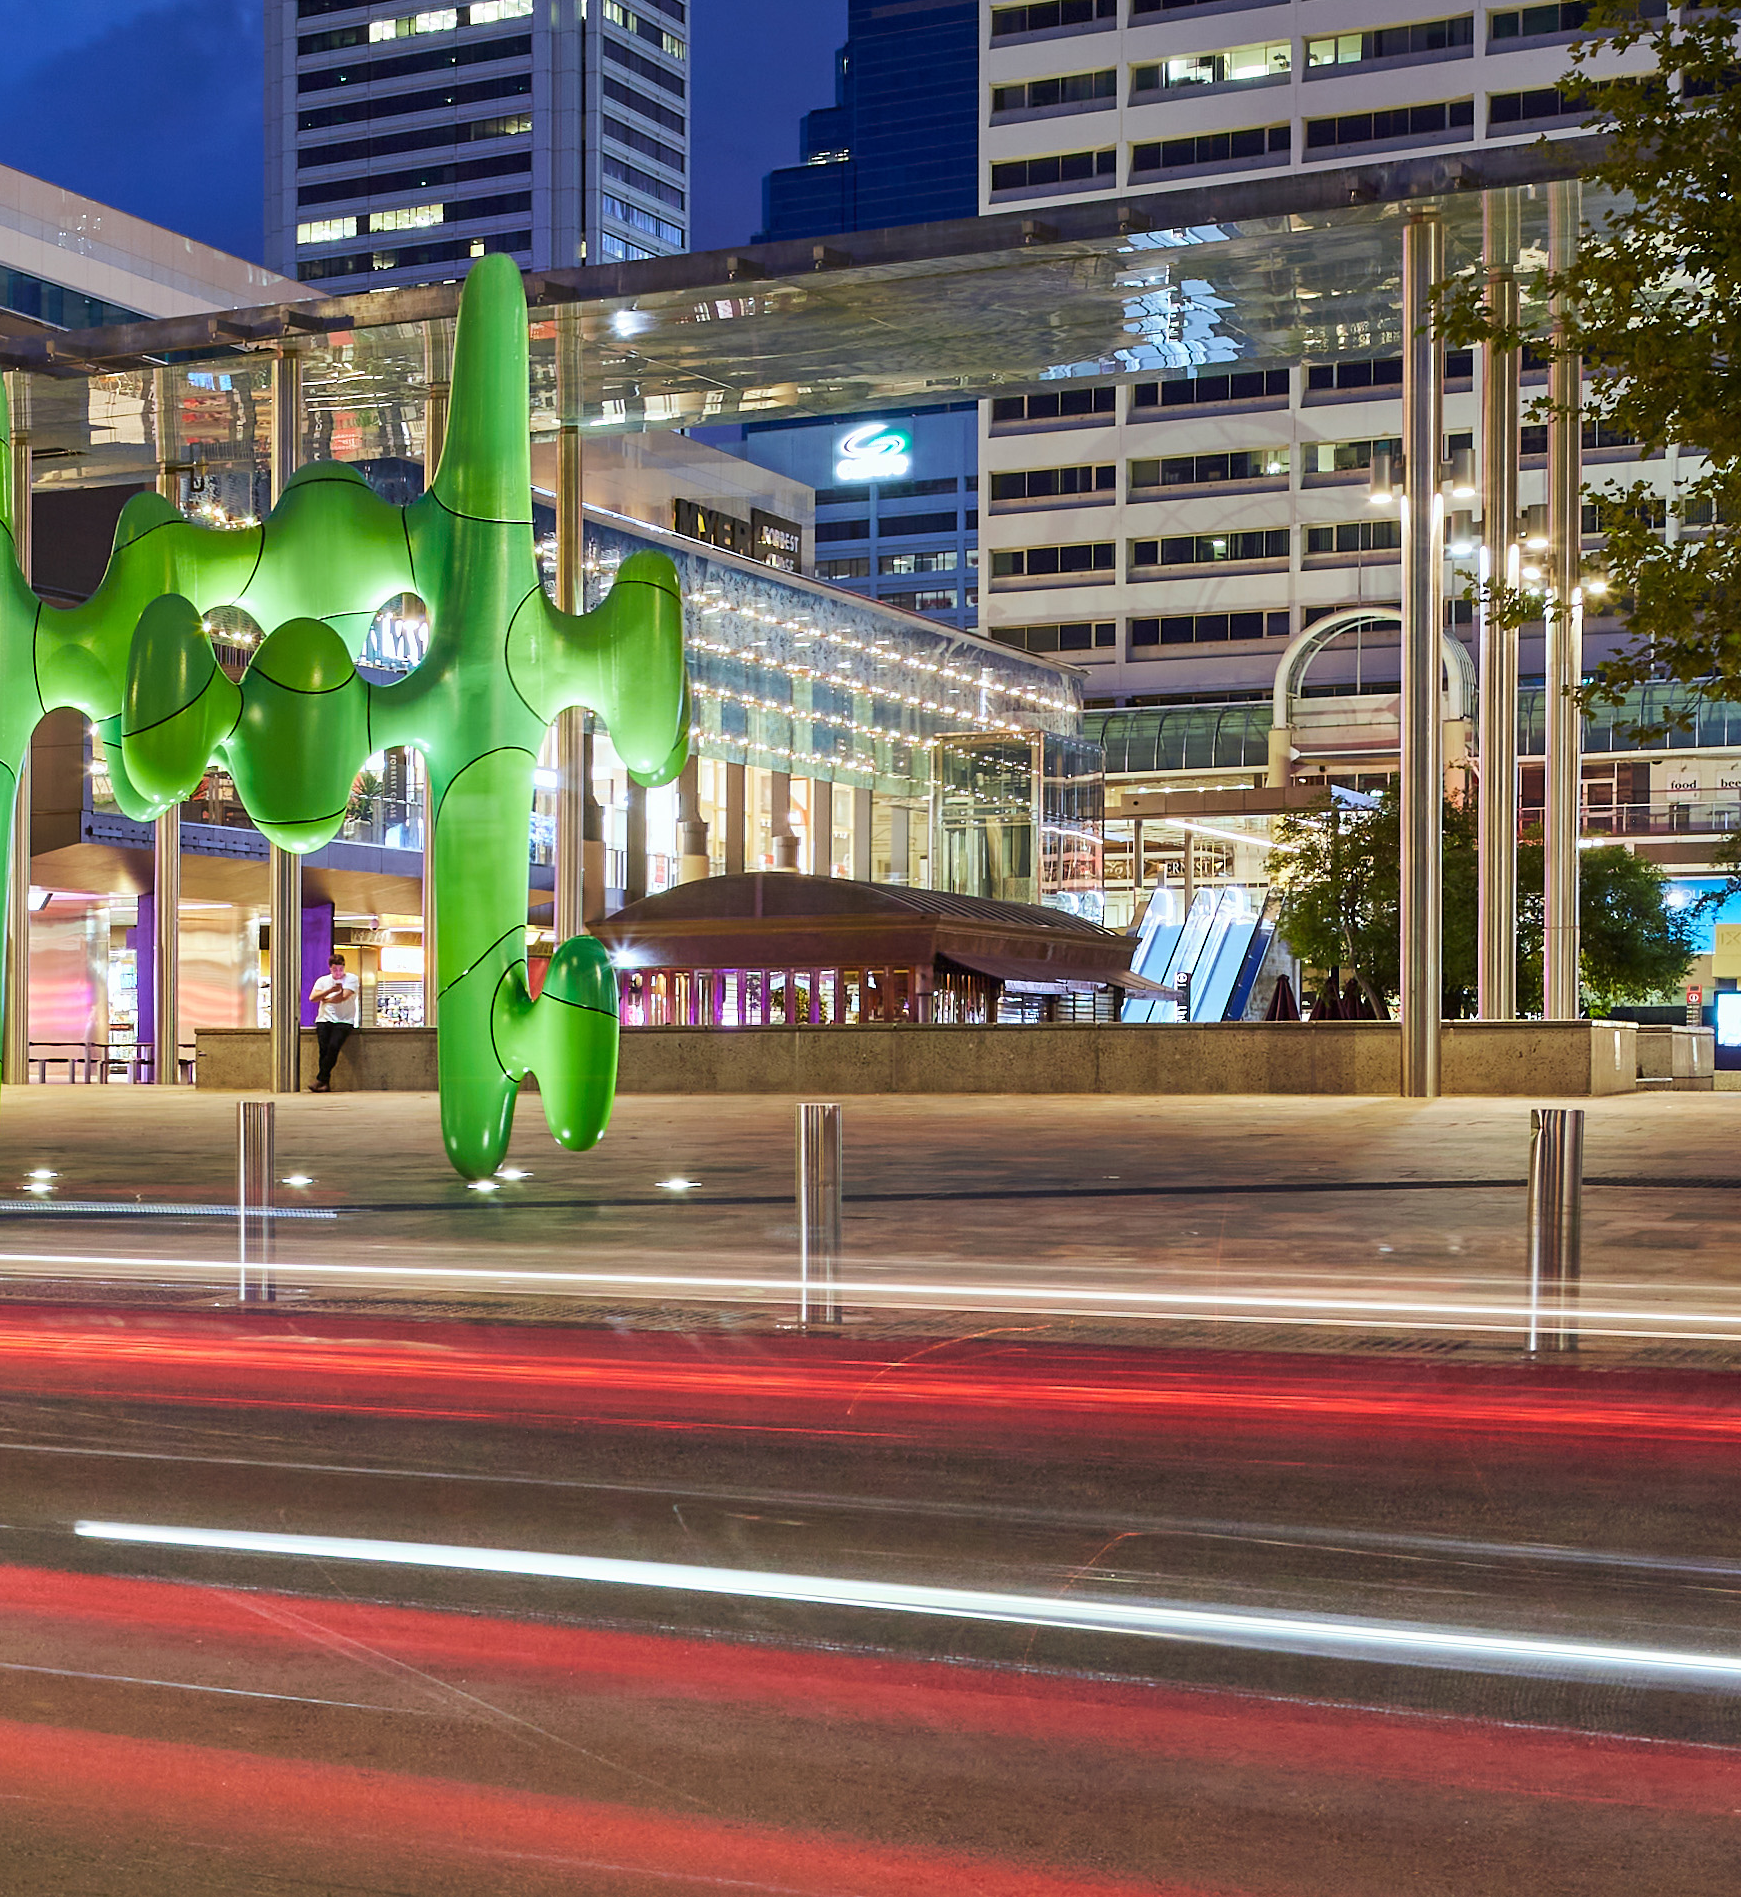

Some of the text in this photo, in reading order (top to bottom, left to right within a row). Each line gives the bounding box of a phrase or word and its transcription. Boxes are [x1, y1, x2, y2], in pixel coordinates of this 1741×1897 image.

[675, 498, 752, 558] MYER
[761, 525, 799, 553] FORREST
[1670, 779, 1697, 790] food
[1167, 860, 1209, 874] ERNST
